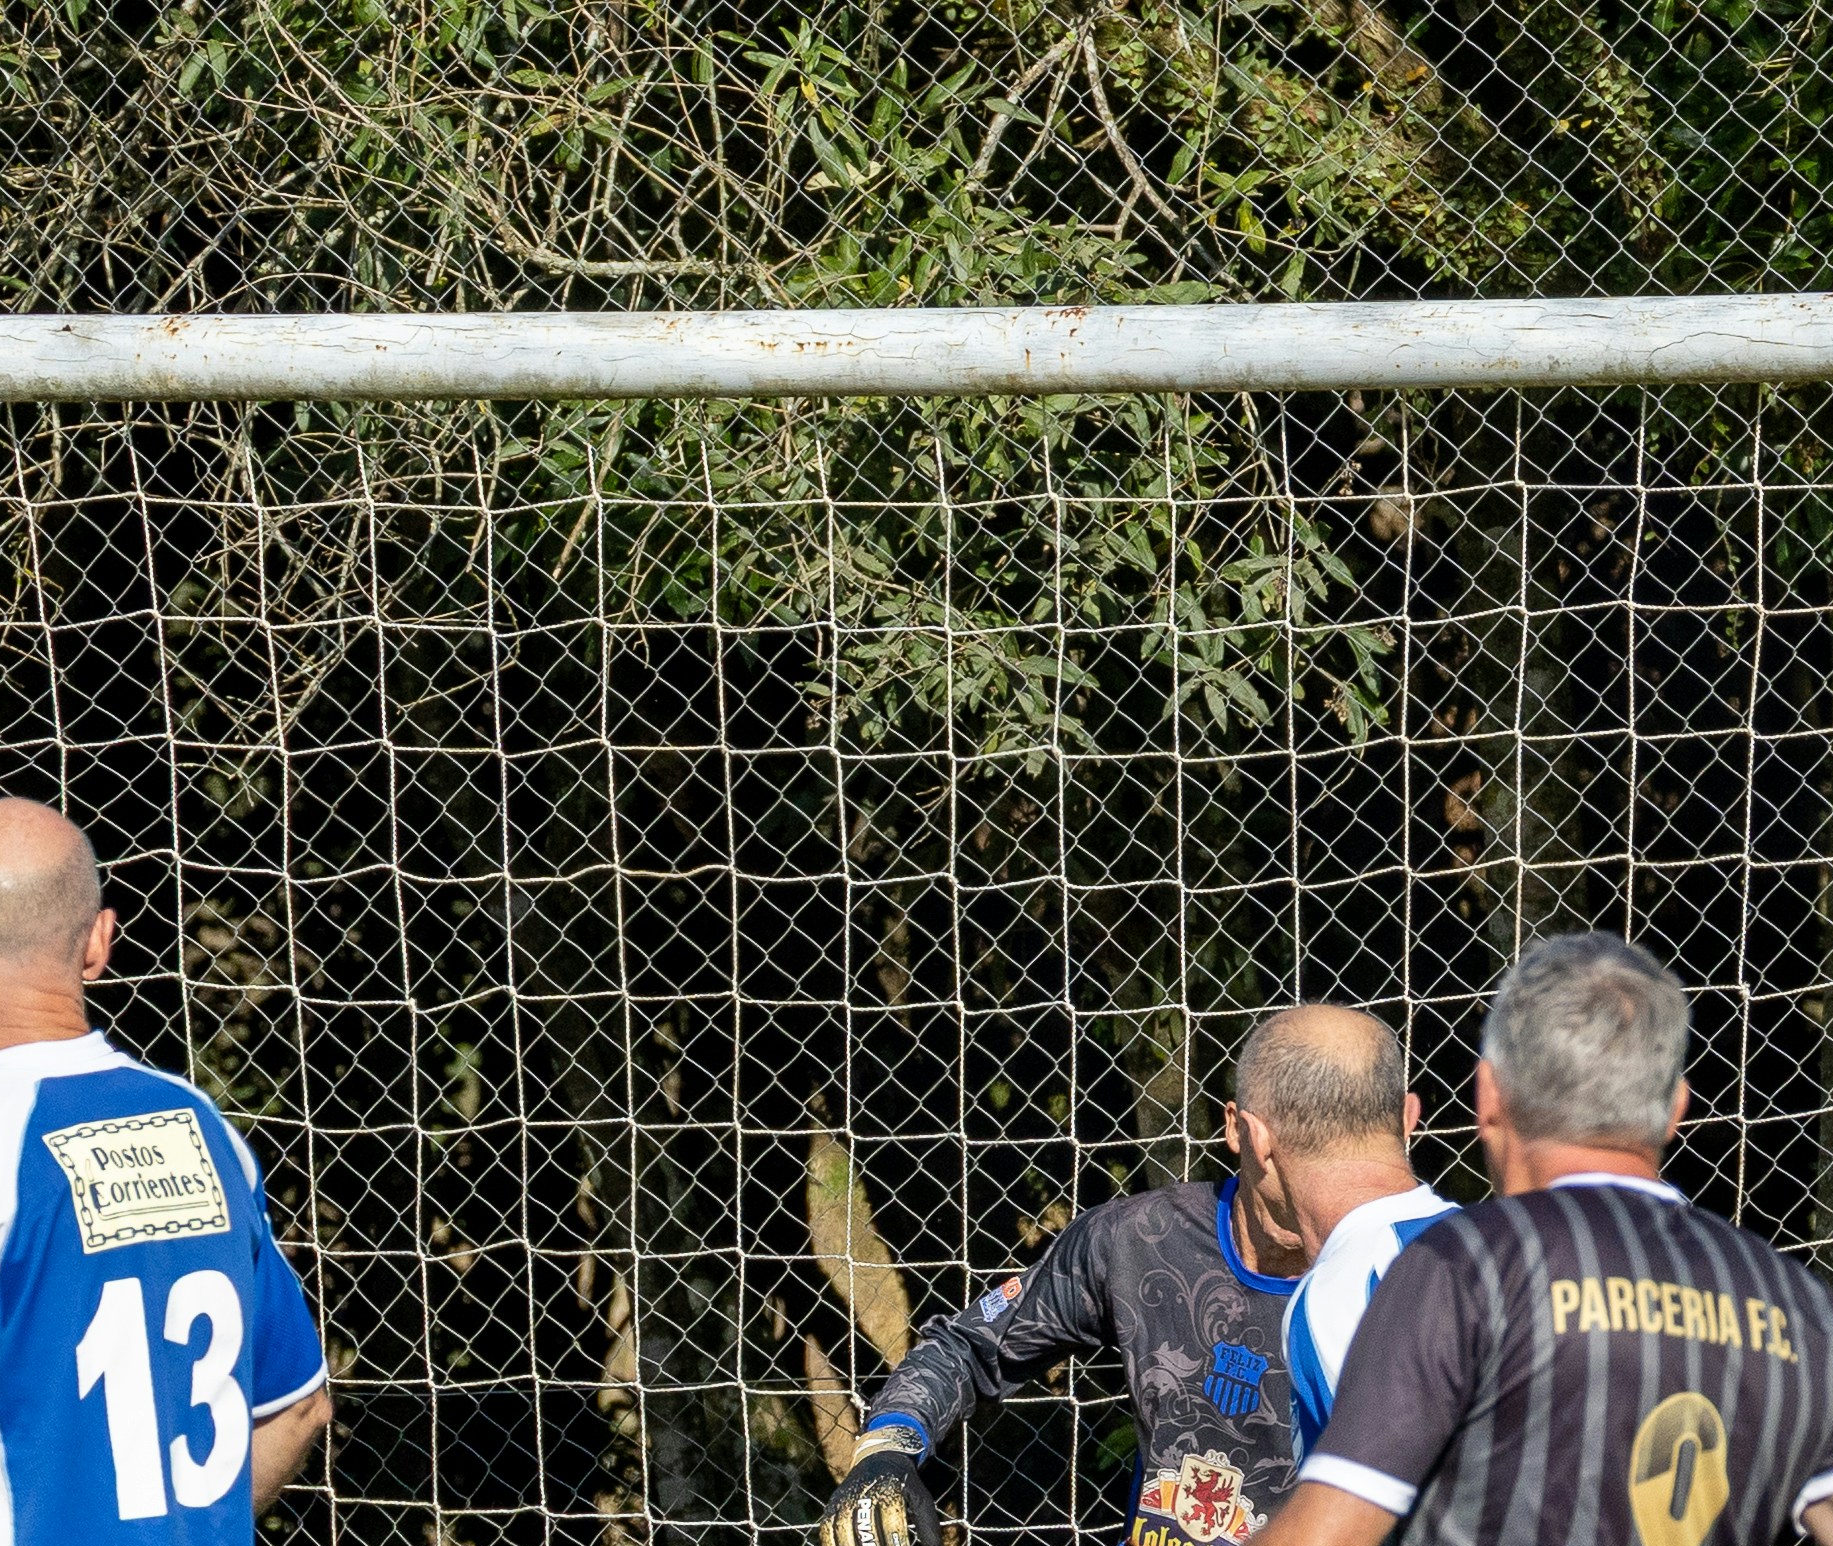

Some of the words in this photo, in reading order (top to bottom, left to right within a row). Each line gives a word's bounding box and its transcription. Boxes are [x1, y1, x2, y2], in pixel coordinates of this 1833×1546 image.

[90, 1144, 165, 1171] Postos
[1551, 1276, 1742, 1348] PARCERIA
[1747, 1298, 1800, 1363] F.C.
[1219, 1346, 1262, 1372] FELIZ
[1225, 1361, 1250, 1381] F.C.
[75, 1269, 251, 1521] 13
